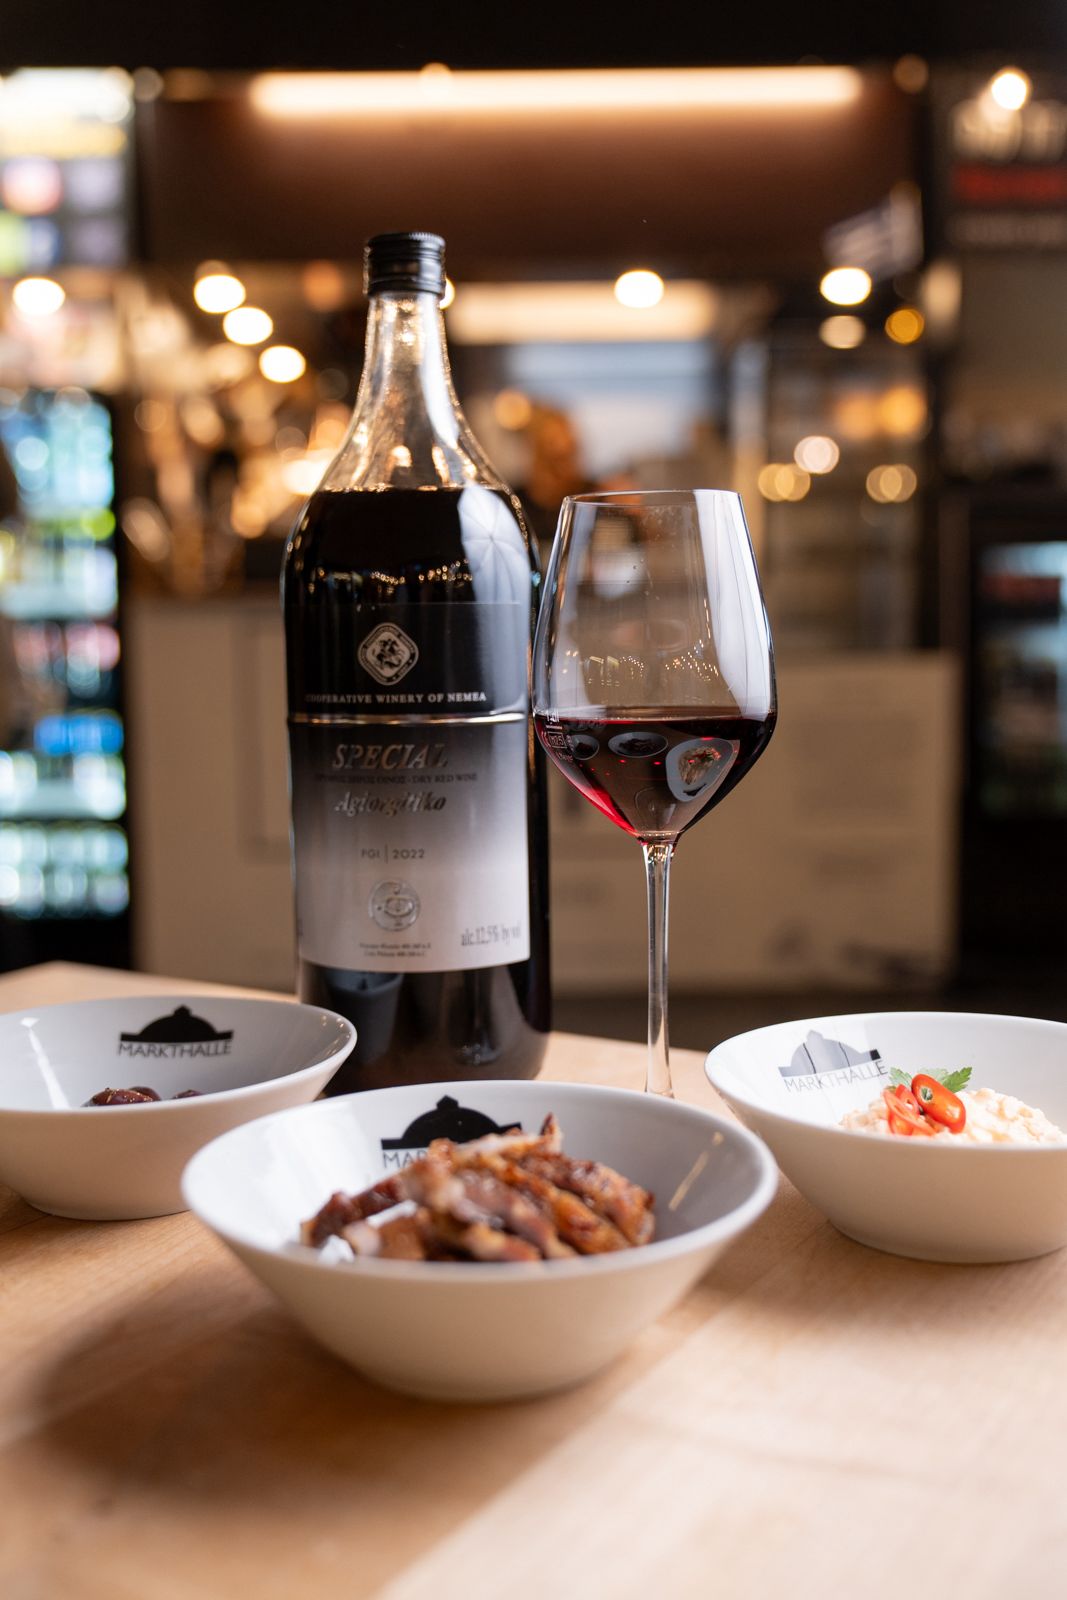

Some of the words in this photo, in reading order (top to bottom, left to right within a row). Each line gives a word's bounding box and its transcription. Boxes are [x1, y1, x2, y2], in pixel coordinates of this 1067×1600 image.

[376, 693, 424, 704] WINERY
[428, 693, 444, 703] OF
[447, 691, 487, 702] NEMEA
[332, 743, 450, 770] SPECIAL
[434, 773, 455, 783] RED
[392, 848, 425, 860] 2022
[118, 1040, 233, 1058] MARKTHALLE
[783, 1059, 889, 1093] MARKTHALLE
